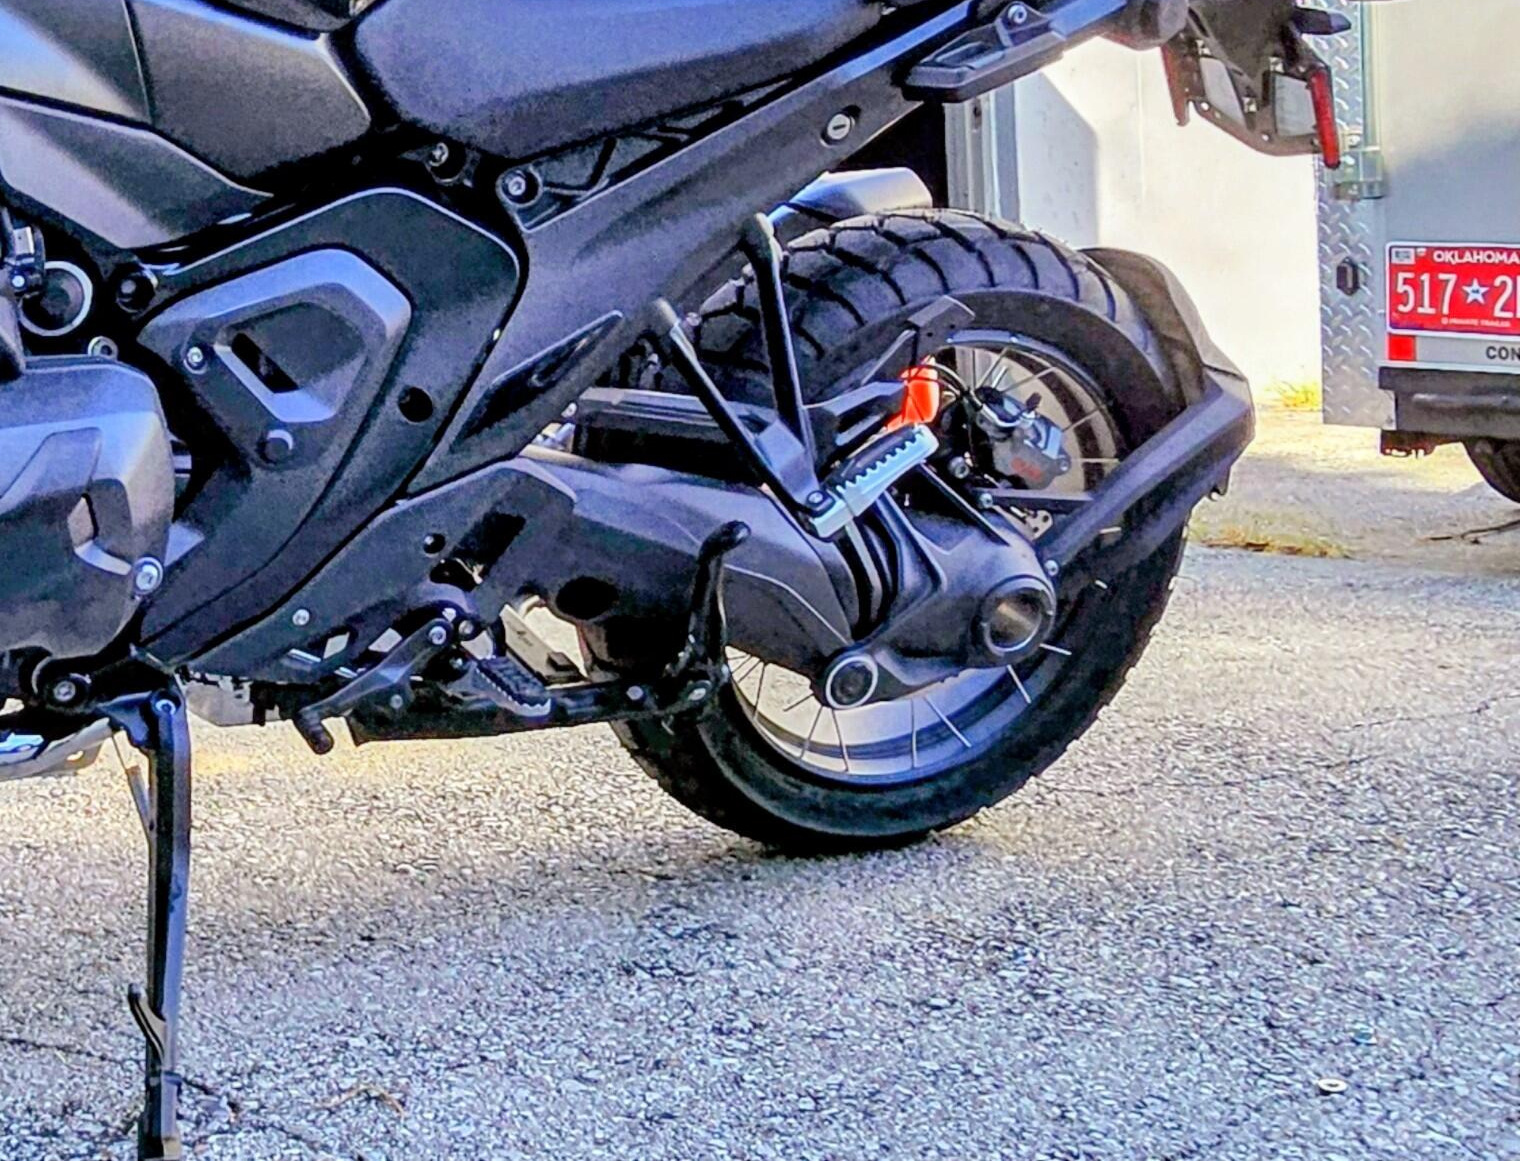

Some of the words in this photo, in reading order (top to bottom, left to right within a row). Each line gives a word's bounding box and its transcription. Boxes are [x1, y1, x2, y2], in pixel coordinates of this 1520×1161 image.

[1433, 250, 1520, 265] OKLAHOMA
[1396, 271, 1459, 316] 517
[1493, 274, 1520, 319] 2
